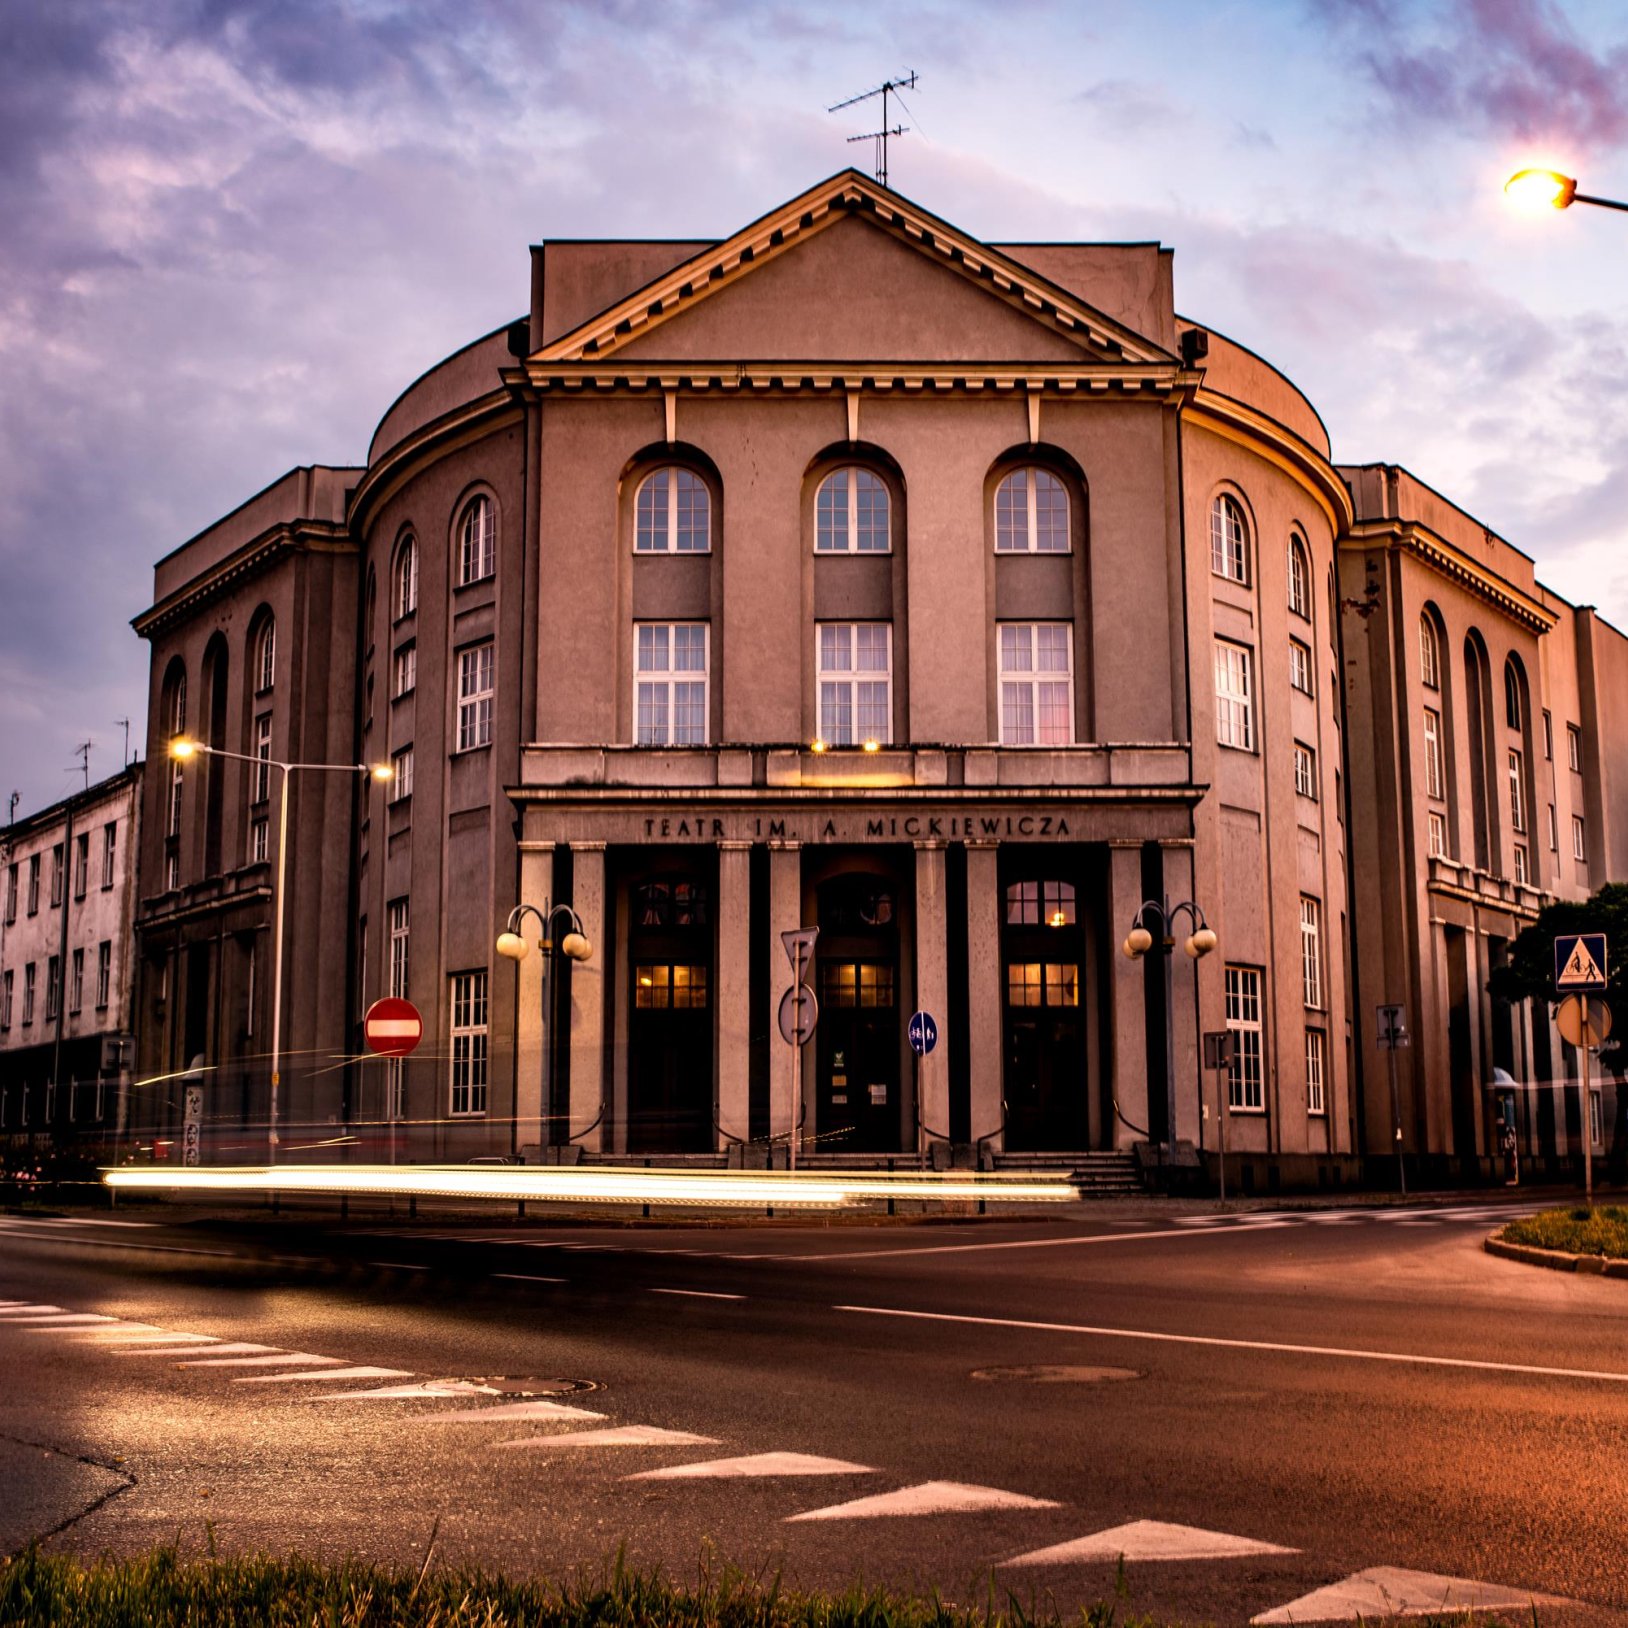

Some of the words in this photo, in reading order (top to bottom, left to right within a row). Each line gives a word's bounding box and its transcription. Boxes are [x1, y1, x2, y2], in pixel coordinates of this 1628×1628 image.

[644, 818, 725, 837] TEATR
[755, 818, 797, 837] IM.
[823, 818, 848, 837] A.
[867, 816, 1069, 836] MICKIEWICZA
